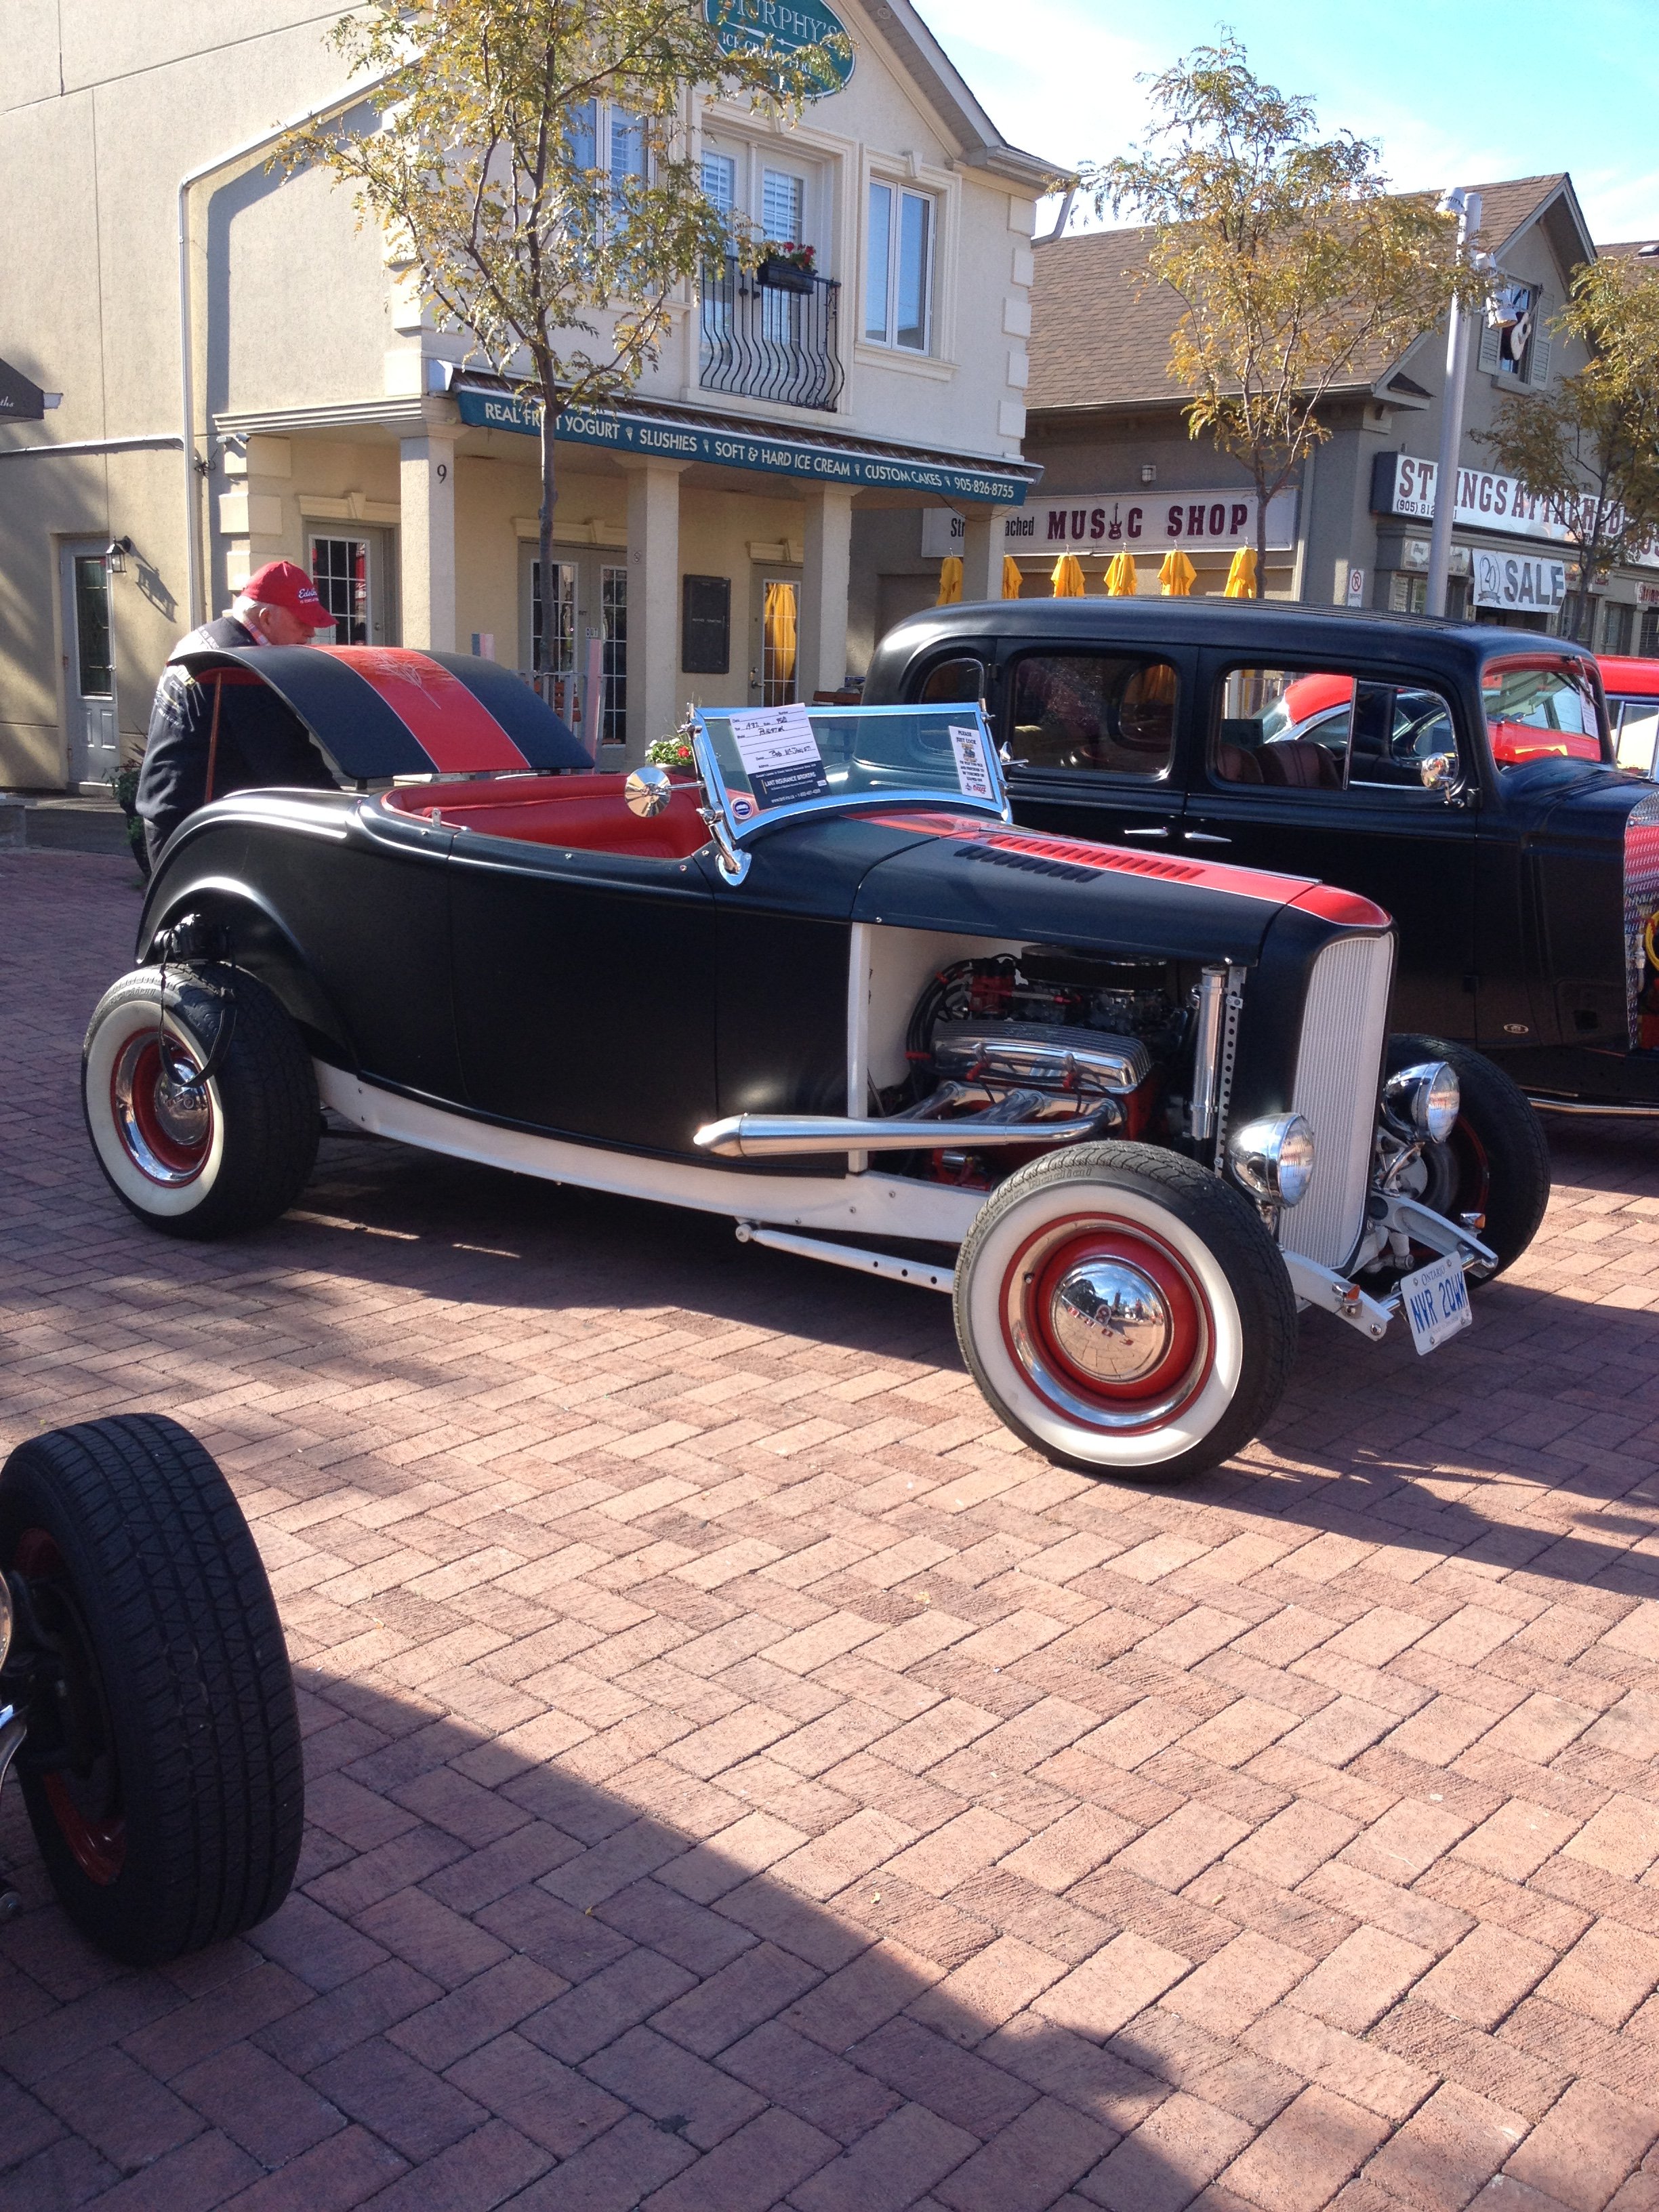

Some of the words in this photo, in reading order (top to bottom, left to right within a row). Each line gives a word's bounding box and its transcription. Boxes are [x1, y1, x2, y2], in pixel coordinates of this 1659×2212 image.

[485, 402, 521, 424] REAL
[525, 409, 562, 430] FRT
[565, 414, 620, 440] YOGURT
[640, 428, 697, 452] SLUSHIES
[715, 441, 745, 460] SOFT
[747, 447, 758, 462] &
[761, 449, 792, 467] HARD
[794, 453, 811, 470] ICE
[813, 457, 851, 476] CREAM
[865, 464, 911, 483] CUSTOM
[911, 471, 943, 487] CAKES
[436, 464, 447, 485] 9
[1396, 499, 1418, 515] (905)
[1399, 459, 1509, 516] STNGS
[1511, 483, 1622, 535] ATTAHD
[1005, 516, 1035, 537] ached
[1047, 503, 1143, 540] MUSIC
[1167, 504, 1248, 537] SHOP
[1503, 560, 1565, 607] SALE
[1420, 1265, 1446, 1286] ONTARIO
[1410, 1288, 1439, 1334] NVR
